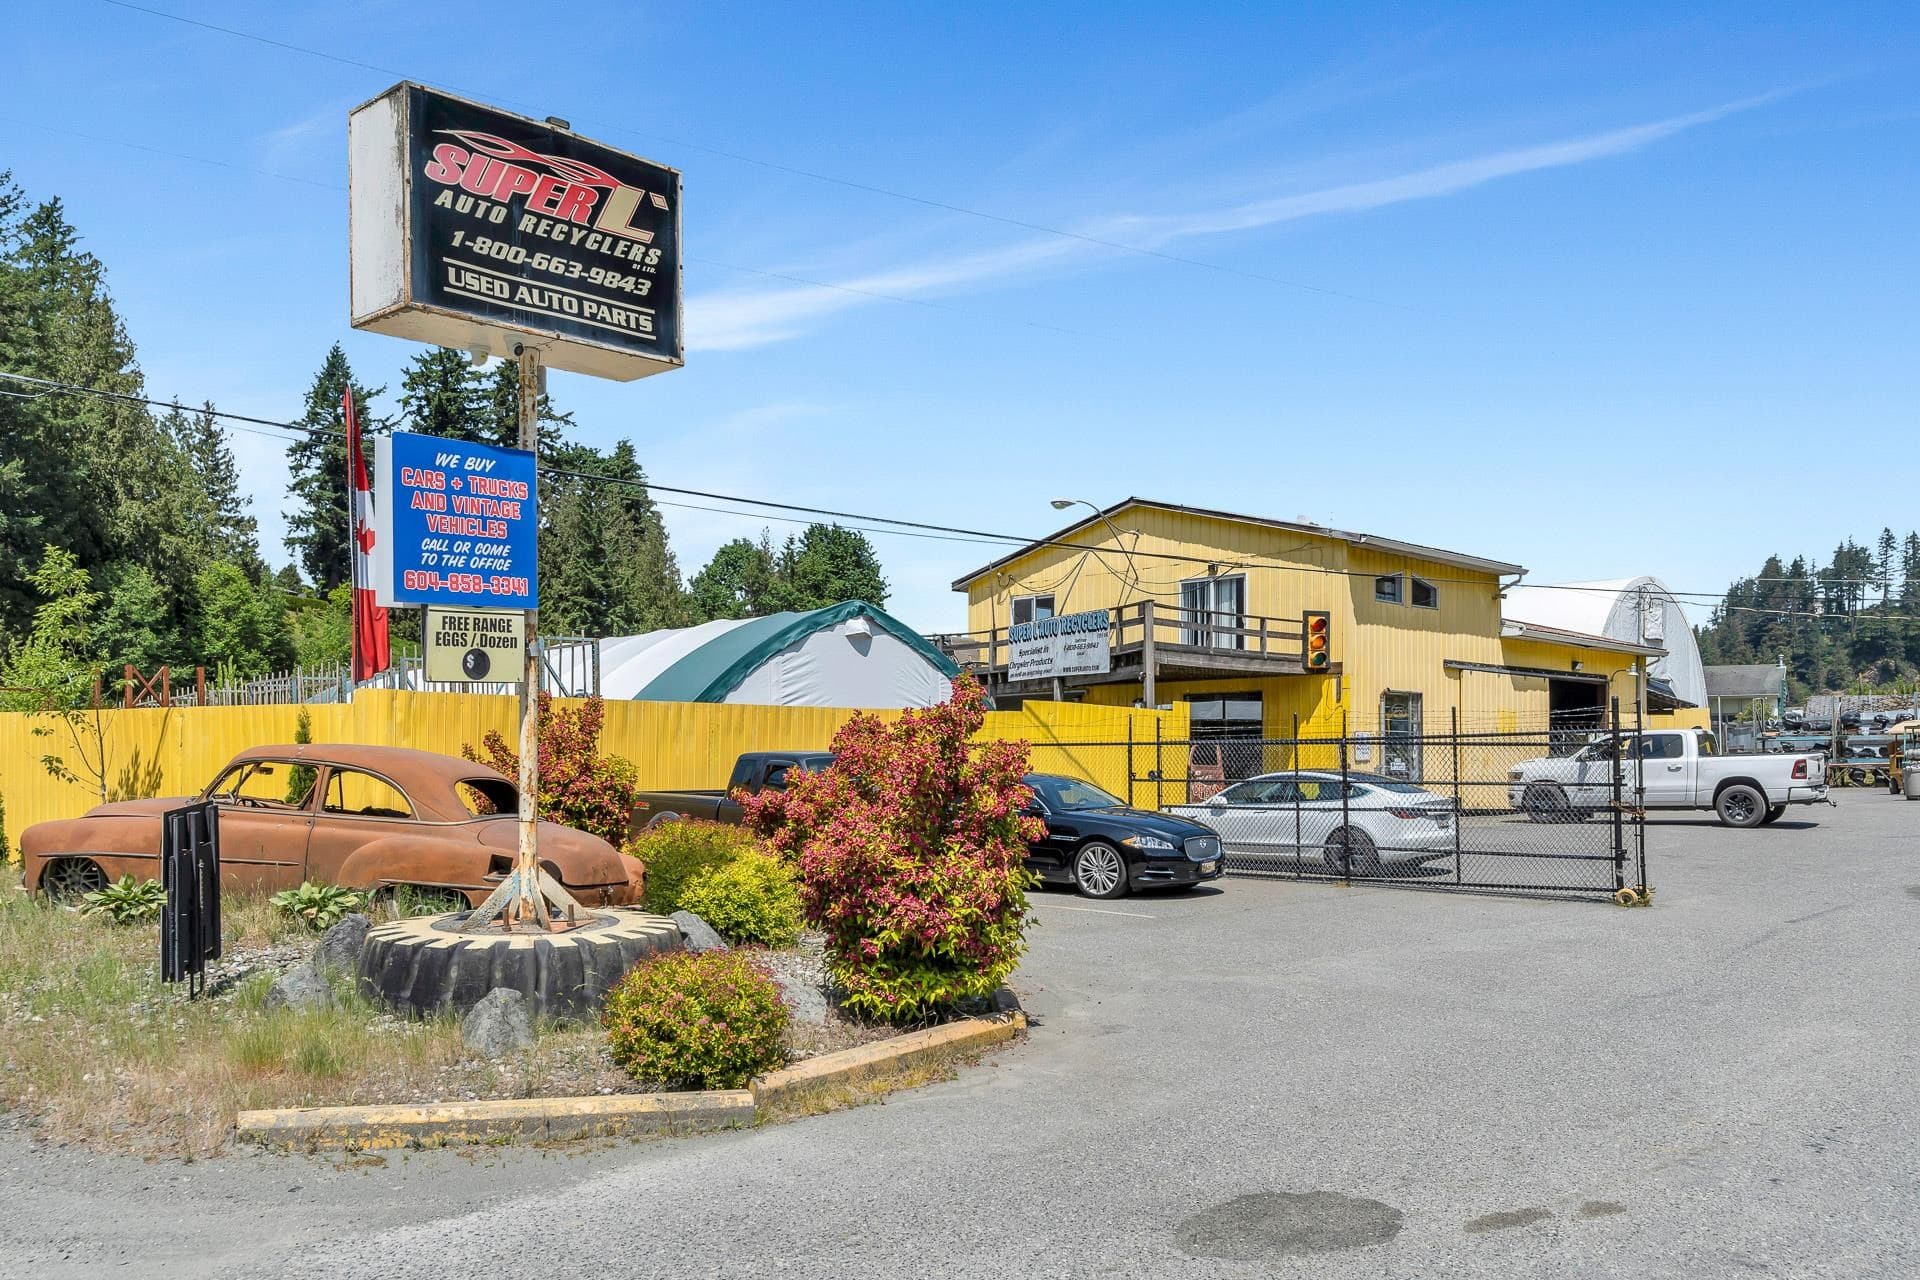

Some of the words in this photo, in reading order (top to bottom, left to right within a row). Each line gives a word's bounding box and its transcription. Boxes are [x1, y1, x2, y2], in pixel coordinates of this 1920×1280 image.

[424, 143, 599, 226] SUPER
[434, 189, 507, 224] AUTO
[518, 213, 662, 265] RECYCLERS
[451, 230, 652, 296] 1-800-663-9843
[447, 266, 510, 299] USED
[513, 283, 579, 314] AUTO
[583, 303, 653, 332] PARTS
[435, 452, 461, 469] WE
[464, 456, 496, 472] BUY
[401, 467, 446, 490] CARS
[451, 477, 463, 490] +
[467, 475, 528, 500] TRUCKS
[411, 491, 447, 512] AND
[452, 495, 521, 520] VINTAGE
[426, 514, 508, 539] VEHICLES
[421, 538, 449, 553] CALL
[453, 541, 471, 554] OR
[474, 542, 512, 557] COME
[421, 552, 437, 566] TO
[441, 554, 466, 568] THE
[469, 556, 513, 571] OFFICE
[403, 569, 529, 596] 604-858-3341
[442, 616, 470, 632] FREE
[473, 617, 512, 633] RANGE
[1009, 622, 1032, 645] SUPER
[1039, 617, 1059, 639] AUTO
[1060, 611, 1110, 636] RECYCLERS
[435, 631, 467, 647] EGGS
[1018, 646, 1043, 658] Specialist
[466, 653, 475, 669] $
